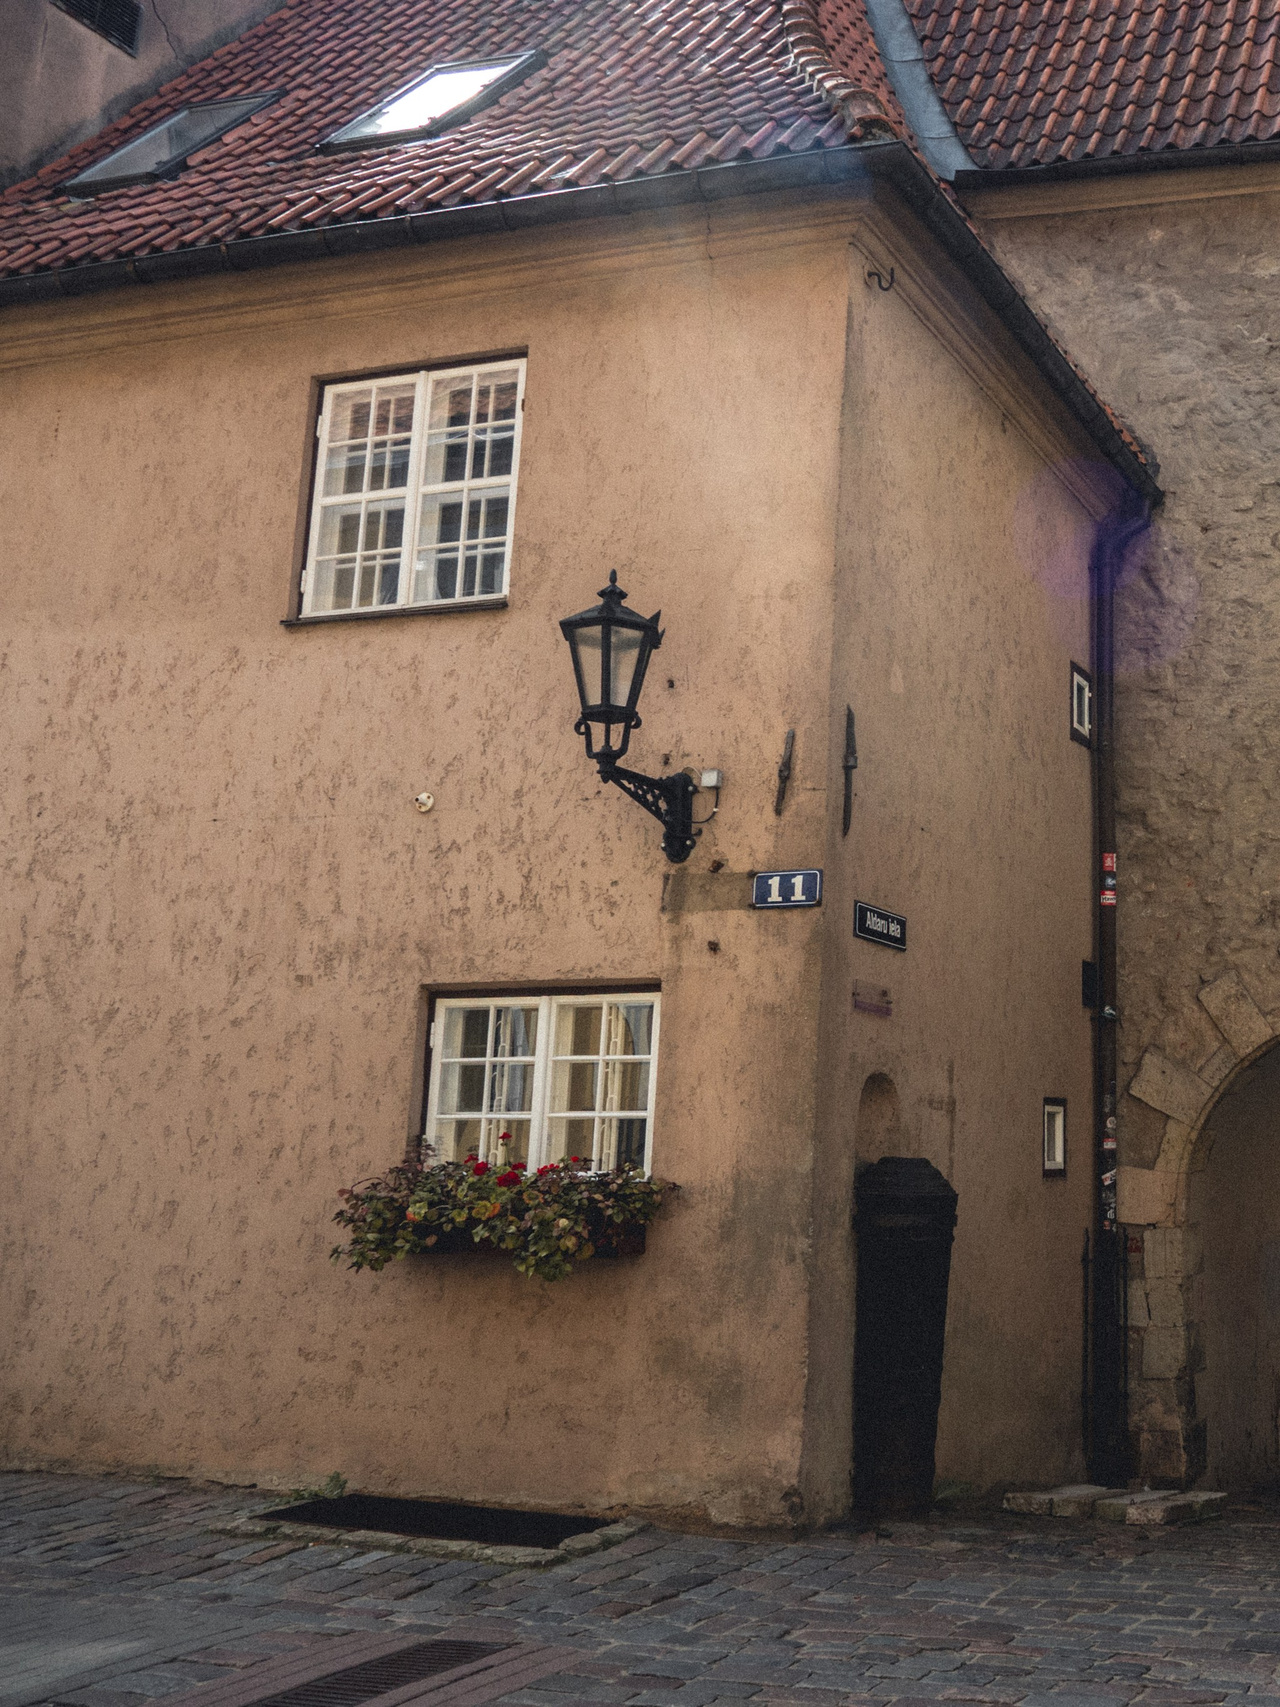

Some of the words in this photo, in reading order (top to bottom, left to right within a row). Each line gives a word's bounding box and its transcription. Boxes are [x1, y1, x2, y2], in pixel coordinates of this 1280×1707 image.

[767, 875, 806, 902] 11
[865, 911, 888, 934] Aldaru
[888, 918, 901, 938] iela
